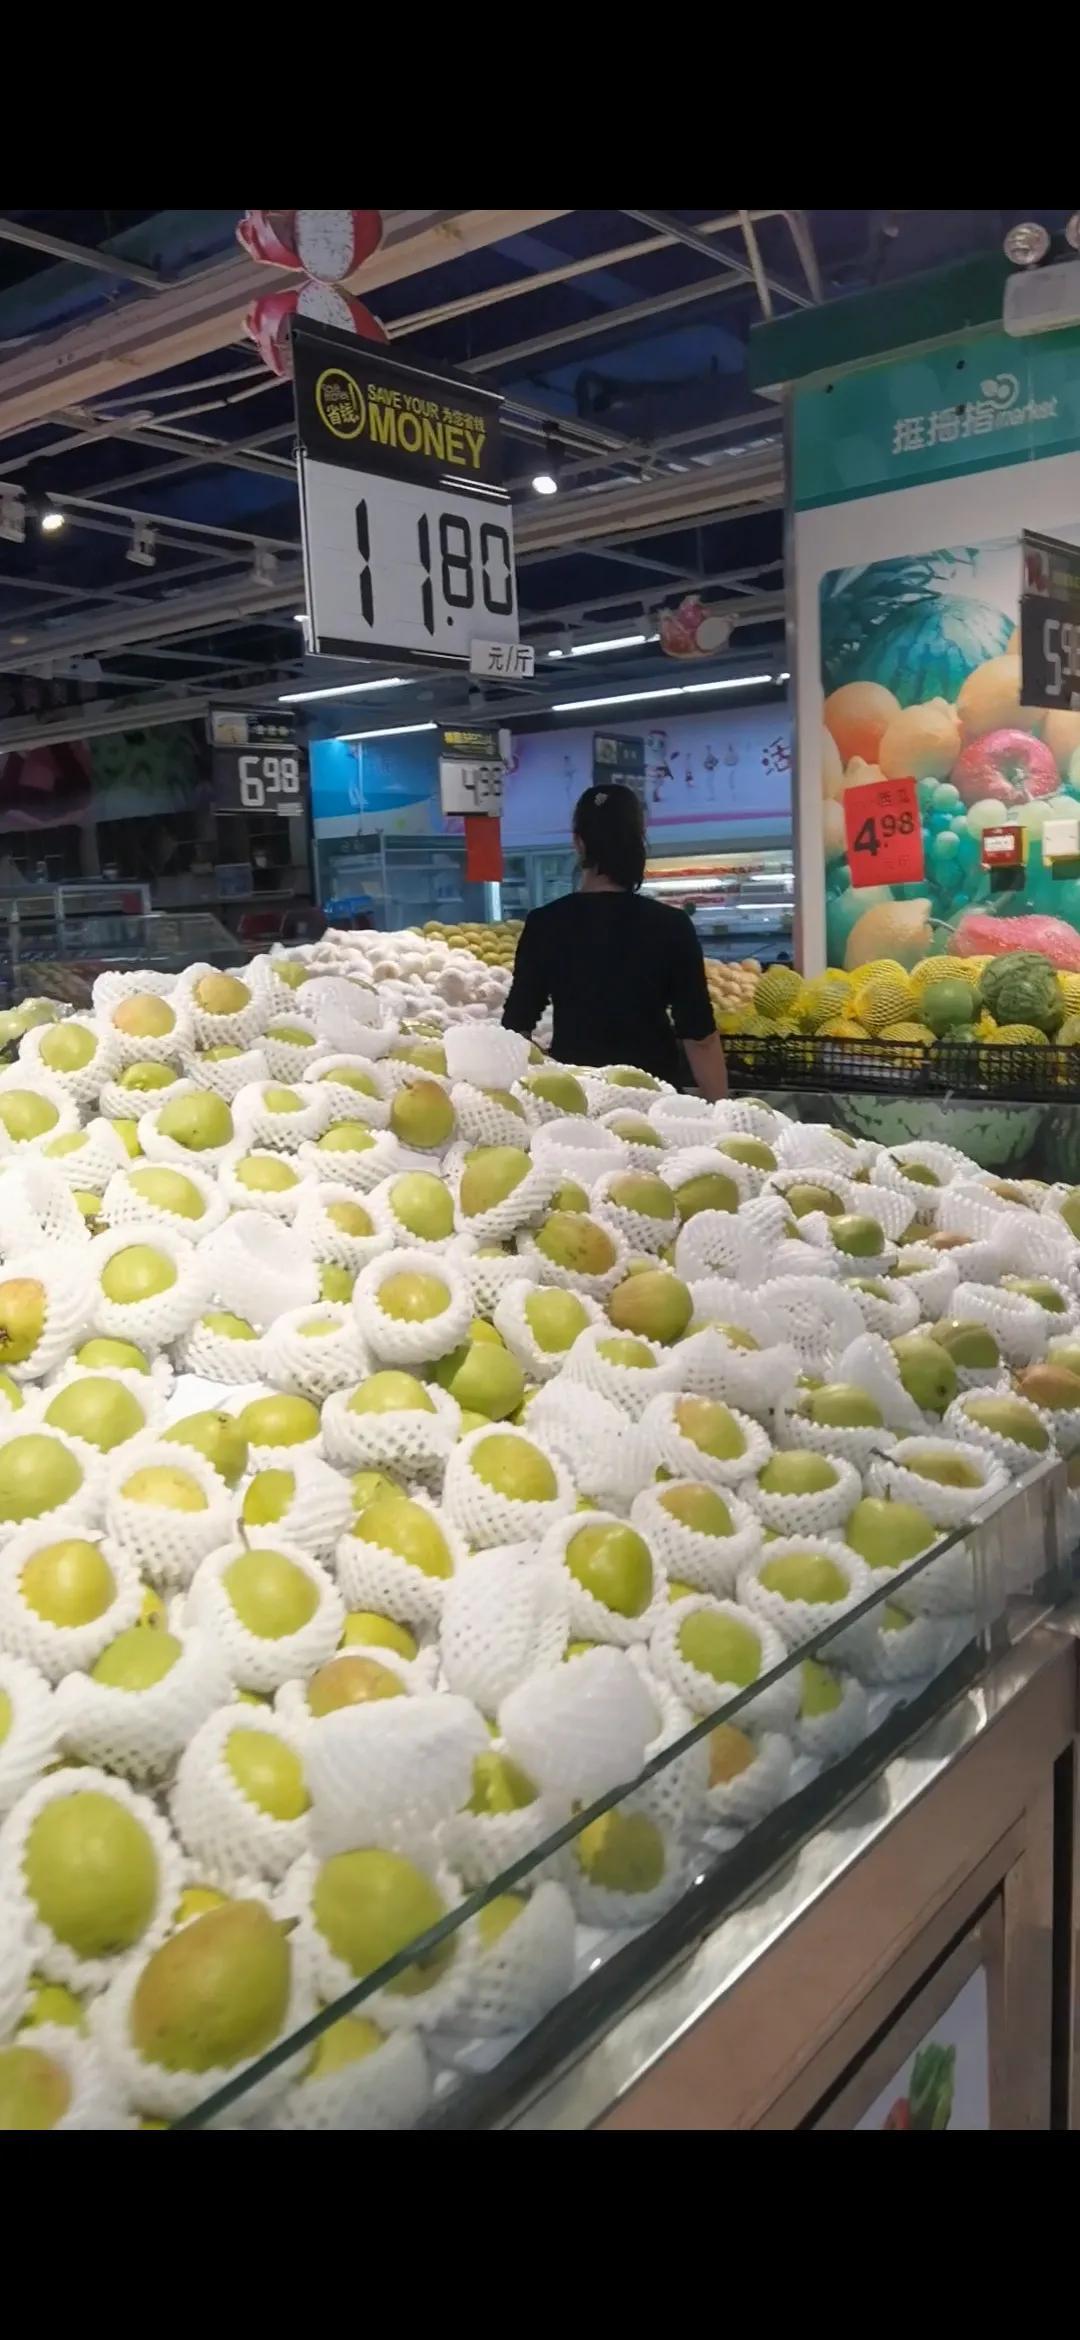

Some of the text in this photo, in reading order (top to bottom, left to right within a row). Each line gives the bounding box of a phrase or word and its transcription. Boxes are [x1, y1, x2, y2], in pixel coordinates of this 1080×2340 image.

[368, 383, 401, 408] SAVE
[403, 394, 439, 419] YOUR
[368, 401, 487, 469] MONEY
[488, 645, 533, 673] 元/斤
